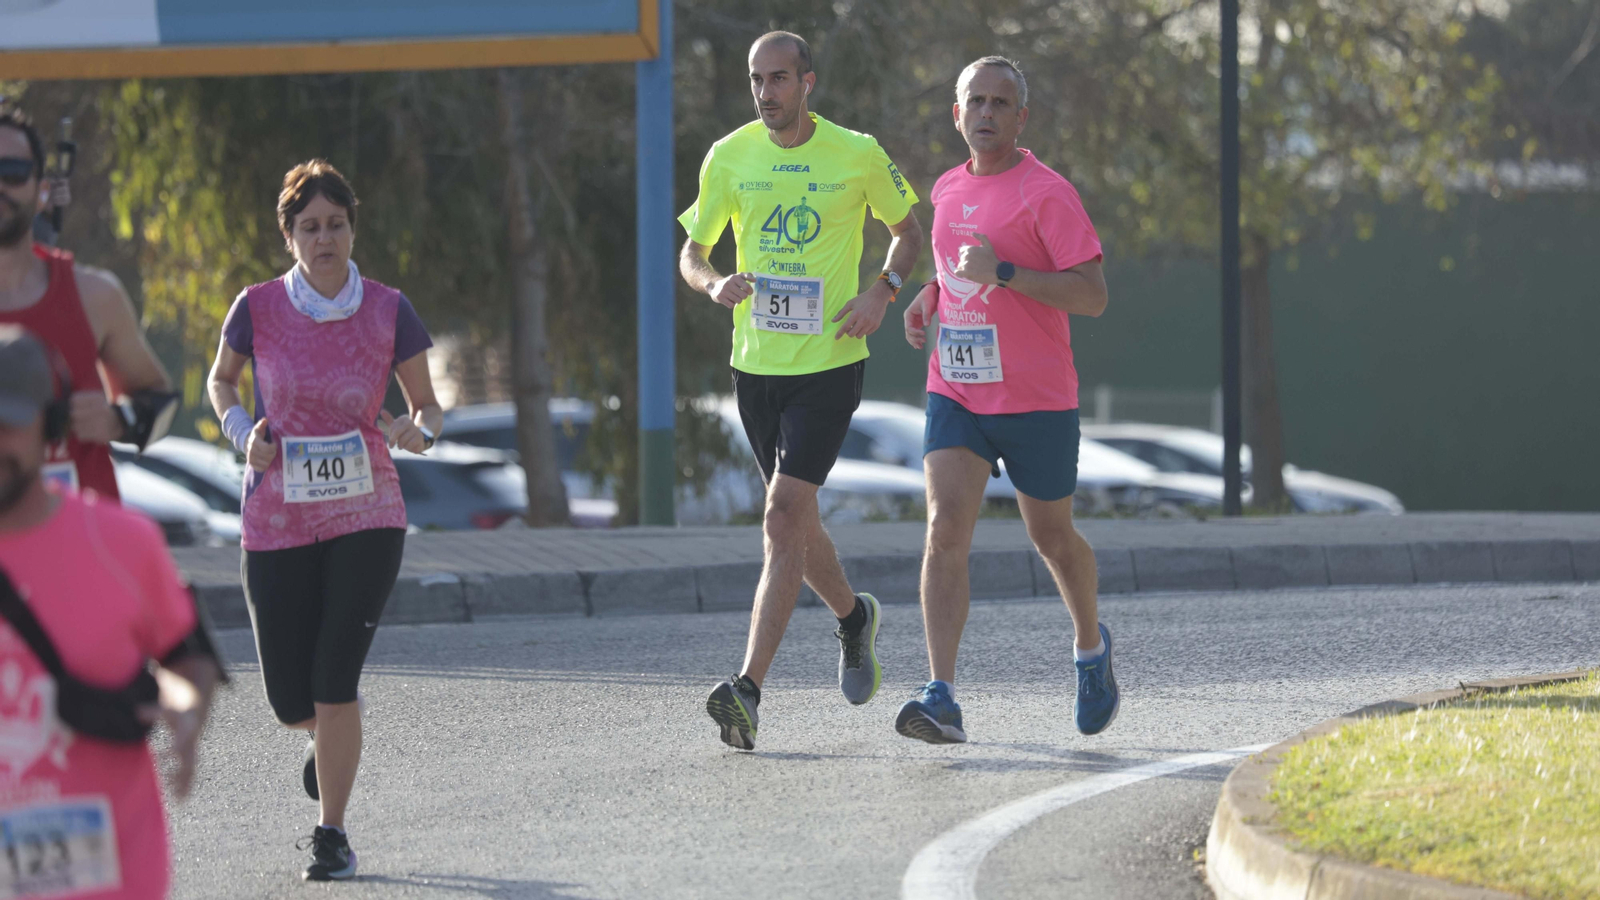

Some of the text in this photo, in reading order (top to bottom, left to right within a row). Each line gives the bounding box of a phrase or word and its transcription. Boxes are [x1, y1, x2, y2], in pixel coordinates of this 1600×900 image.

[772, 164, 810, 173] LEGEA
[745, 181, 773, 189] OVIEDO
[887, 162, 907, 199] LEGEA
[761, 204, 821, 246] 40
[759, 245, 796, 253] silvestre
[778, 262, 807, 273] INTEGRA
[769, 282, 799, 292] MARATÓN
[769, 294, 790, 316] 51
[944, 309, 986, 323] MARATÓN
[766, 320, 799, 330] EVOS
[947, 344, 974, 367] 141
[951, 371, 979, 380] EVOS
[307, 443, 343, 454] MARATÓN
[303, 457, 345, 483] 140
[306, 486, 348, 497] EVOS
